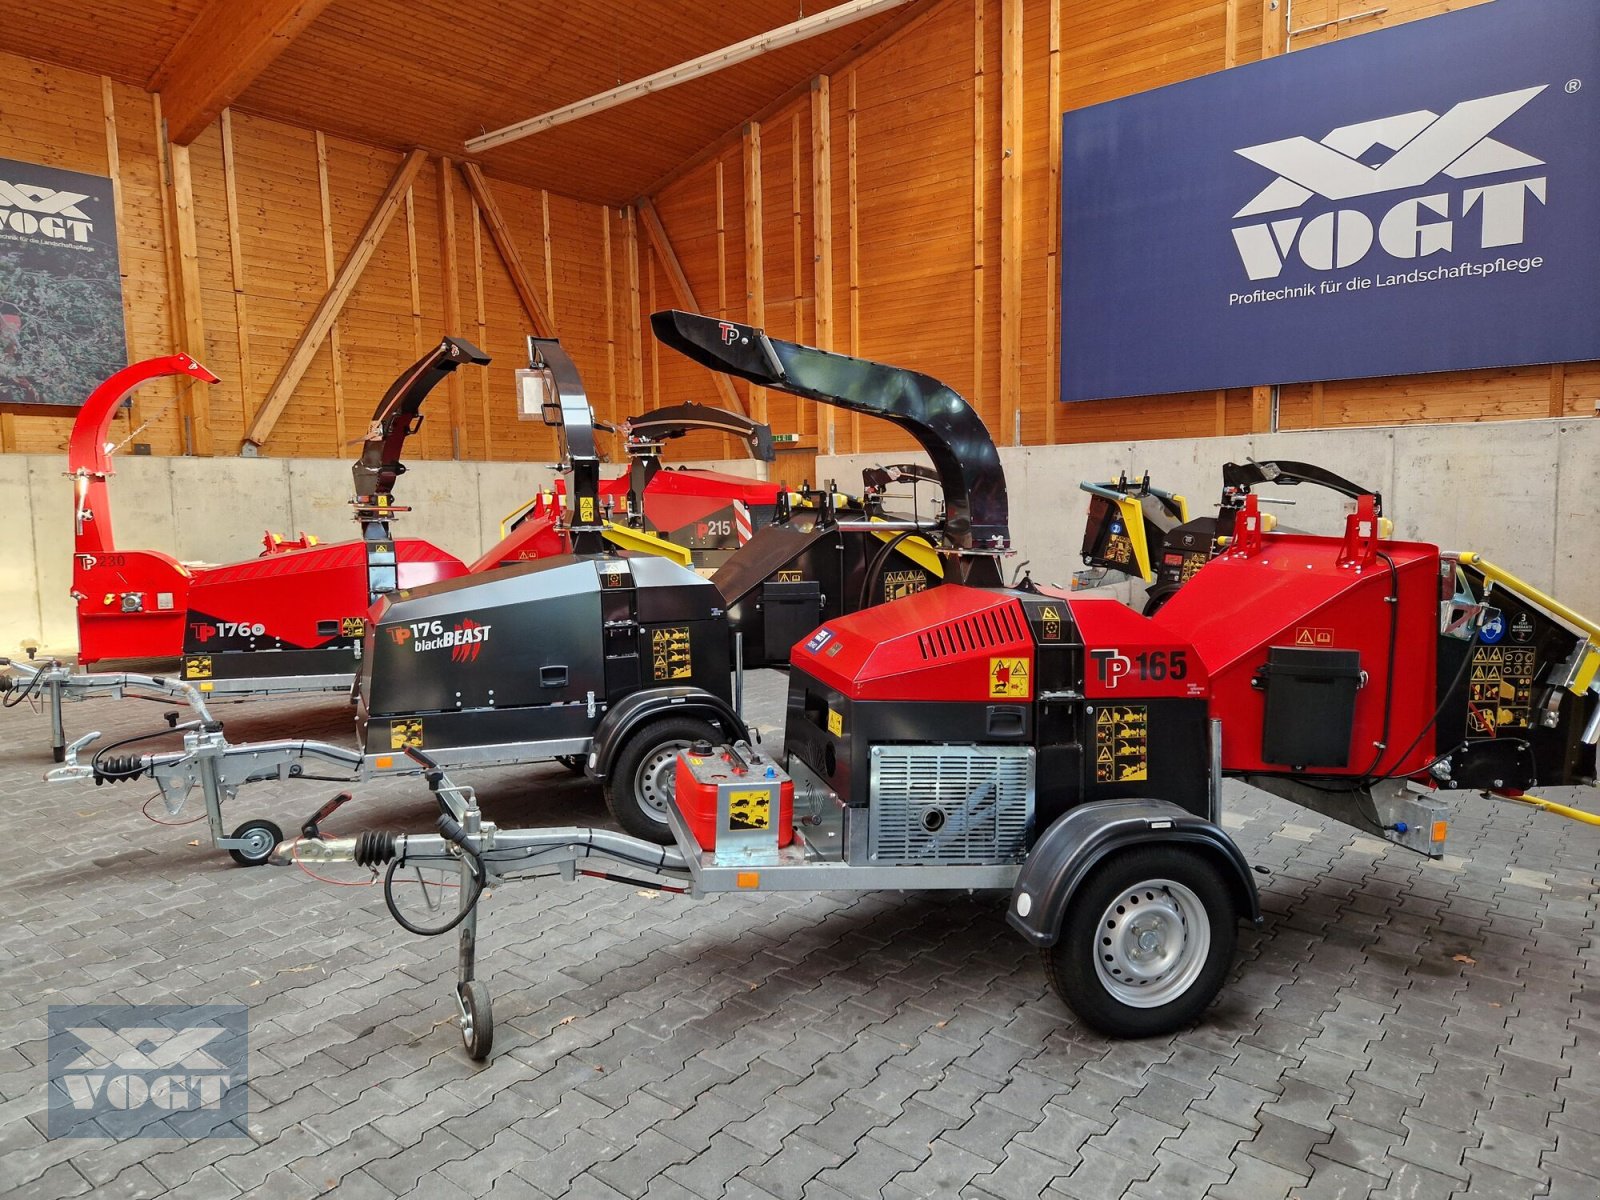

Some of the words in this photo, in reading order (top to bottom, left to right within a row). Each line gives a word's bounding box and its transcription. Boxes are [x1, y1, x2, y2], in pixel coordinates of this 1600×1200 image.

[1231, 177, 1547, 281] VOGT
[1229, 283, 1316, 306] Profitechnik
[1320, 278, 1342, 294] für
[1346, 275, 1371, 292] die
[1376, 255, 1544, 288] Landschaftspflege
[718, 322, 740, 346] TP
[707, 520, 731, 536] 215
[99, 555, 126, 567] 230
[409, 620, 444, 639] 176
[414, 625, 492, 653] blackBEAST
[1089, 648, 1131, 689] TP
[1135, 651, 1187, 681] 165
